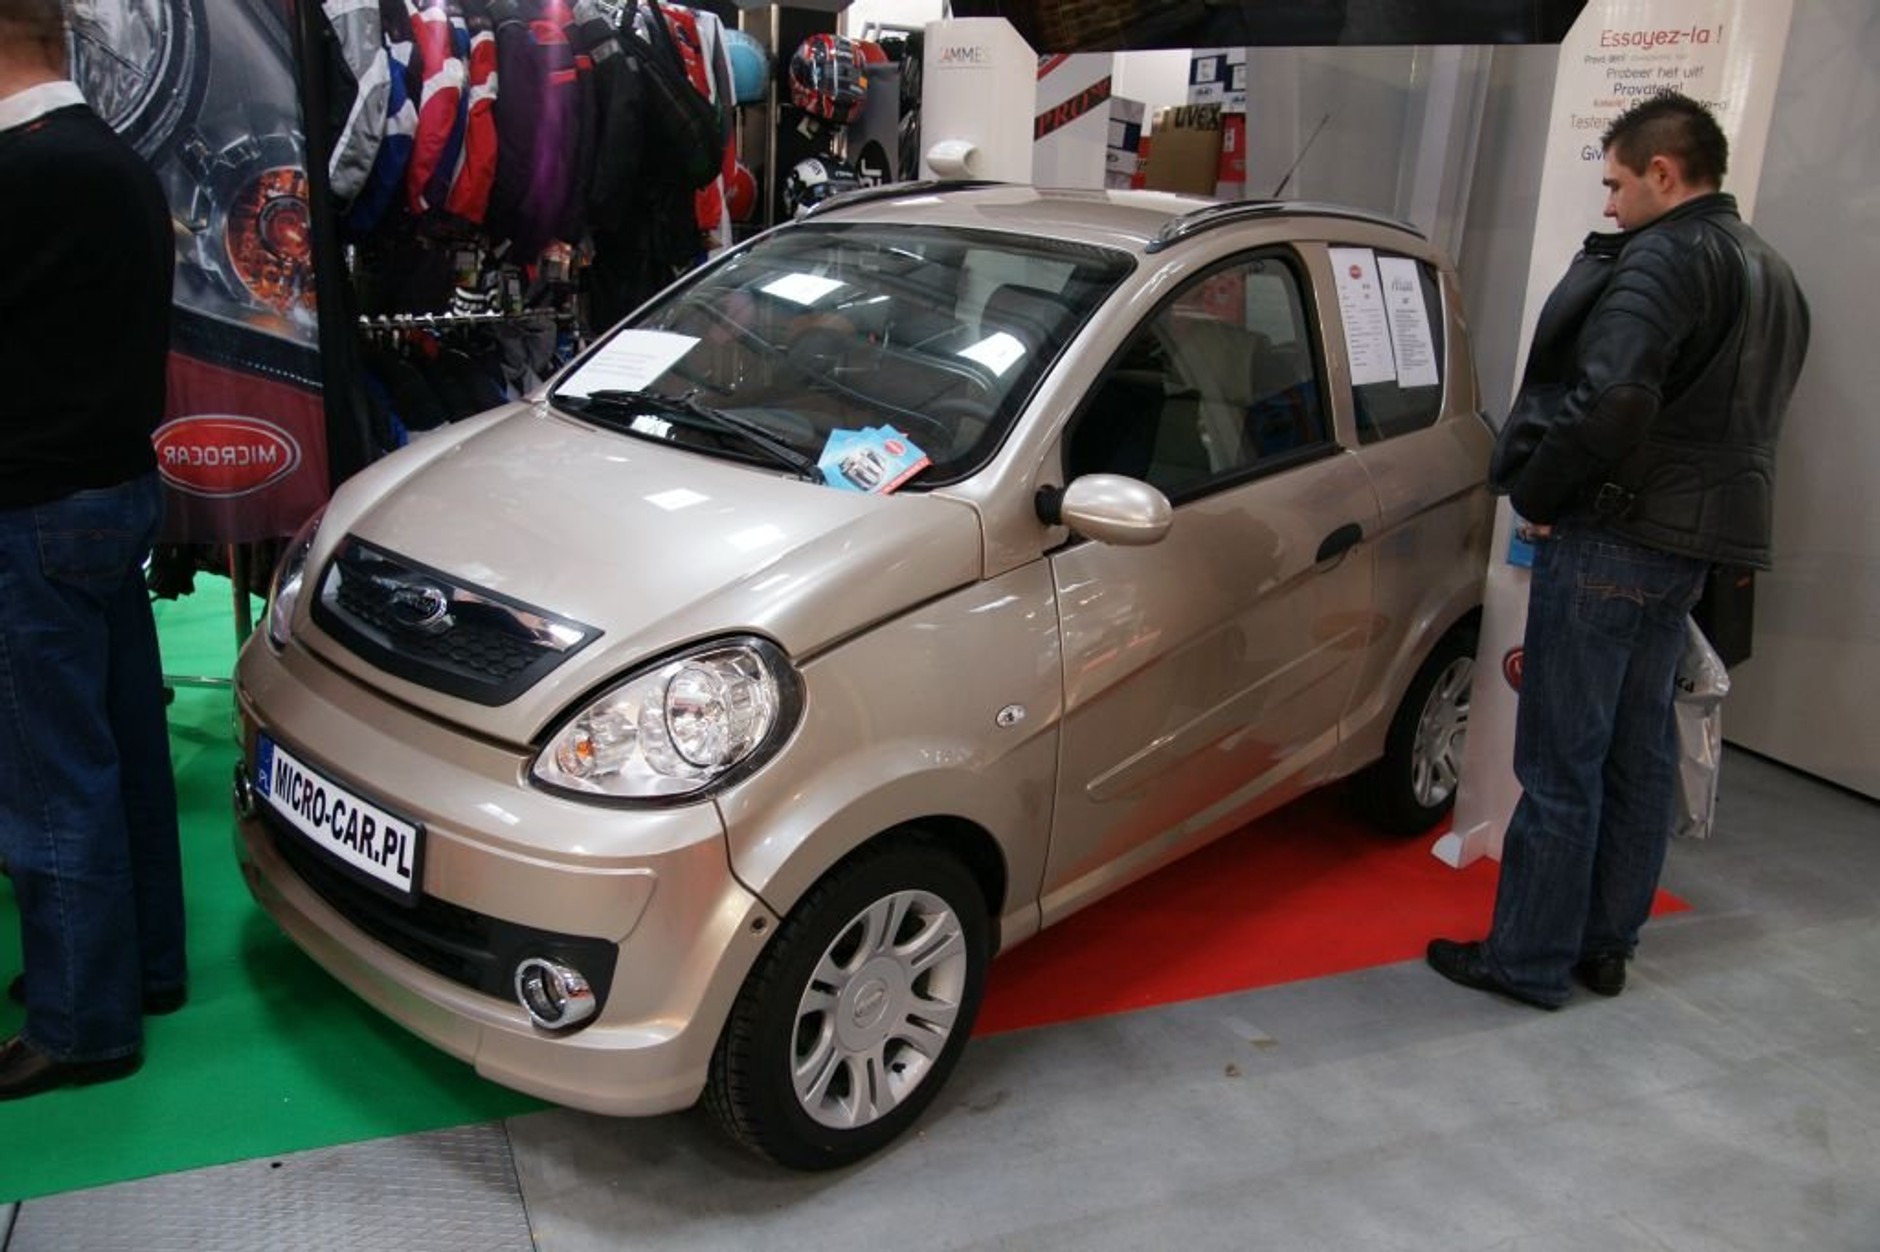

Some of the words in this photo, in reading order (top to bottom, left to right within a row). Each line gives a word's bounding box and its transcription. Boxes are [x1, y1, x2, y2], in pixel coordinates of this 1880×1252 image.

[1600, 25, 1711, 50] Essayez-la
[1716, 24, 1724, 44] !
[1606, 67, 1653, 80] Probeer
[274, 758, 411, 879] MICRO-CAR.PL
